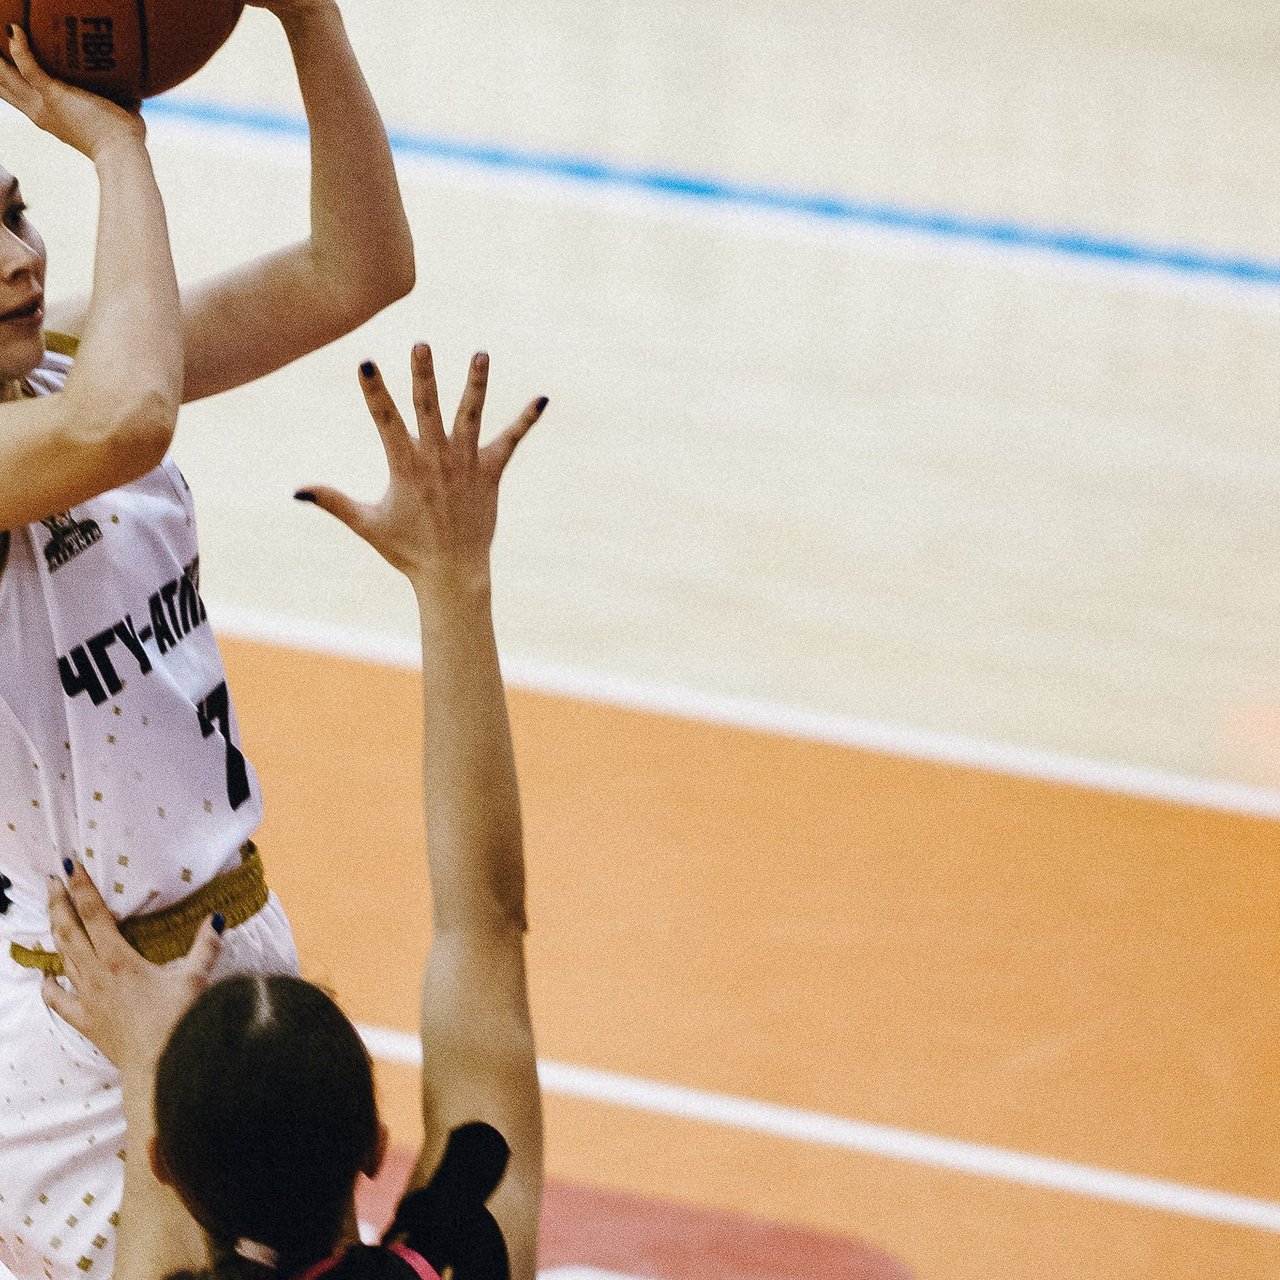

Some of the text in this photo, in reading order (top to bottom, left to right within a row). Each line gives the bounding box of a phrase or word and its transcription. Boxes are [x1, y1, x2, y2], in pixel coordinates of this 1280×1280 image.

[81, 16, 116, 71] FIBA
[57, 573, 208, 706] ЧГУ-АТЛ
[196, 679, 251, 812] 7
